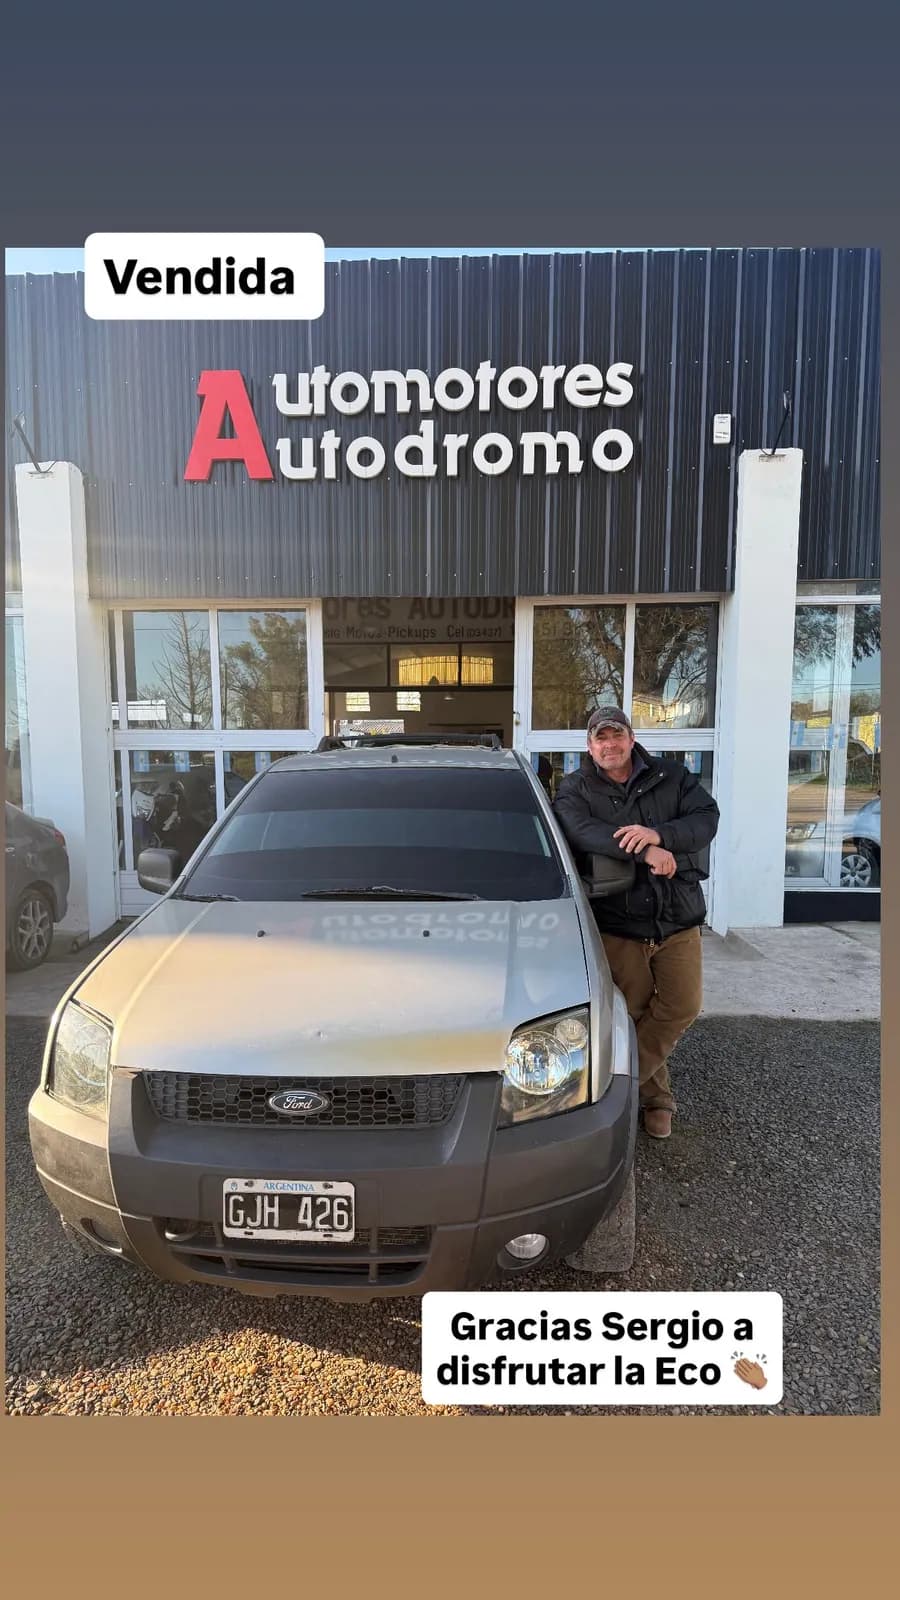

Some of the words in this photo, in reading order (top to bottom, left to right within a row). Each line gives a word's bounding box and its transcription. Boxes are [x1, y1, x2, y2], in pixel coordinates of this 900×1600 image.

[388, 625, 437, 640] Pickups
[283, 1095, 313, 1109] Ford
[264, 1181, 315, 1192] ARGENTINA
[228, 1195, 280, 1228] GJH
[297, 1197, 349, 1230] 426
